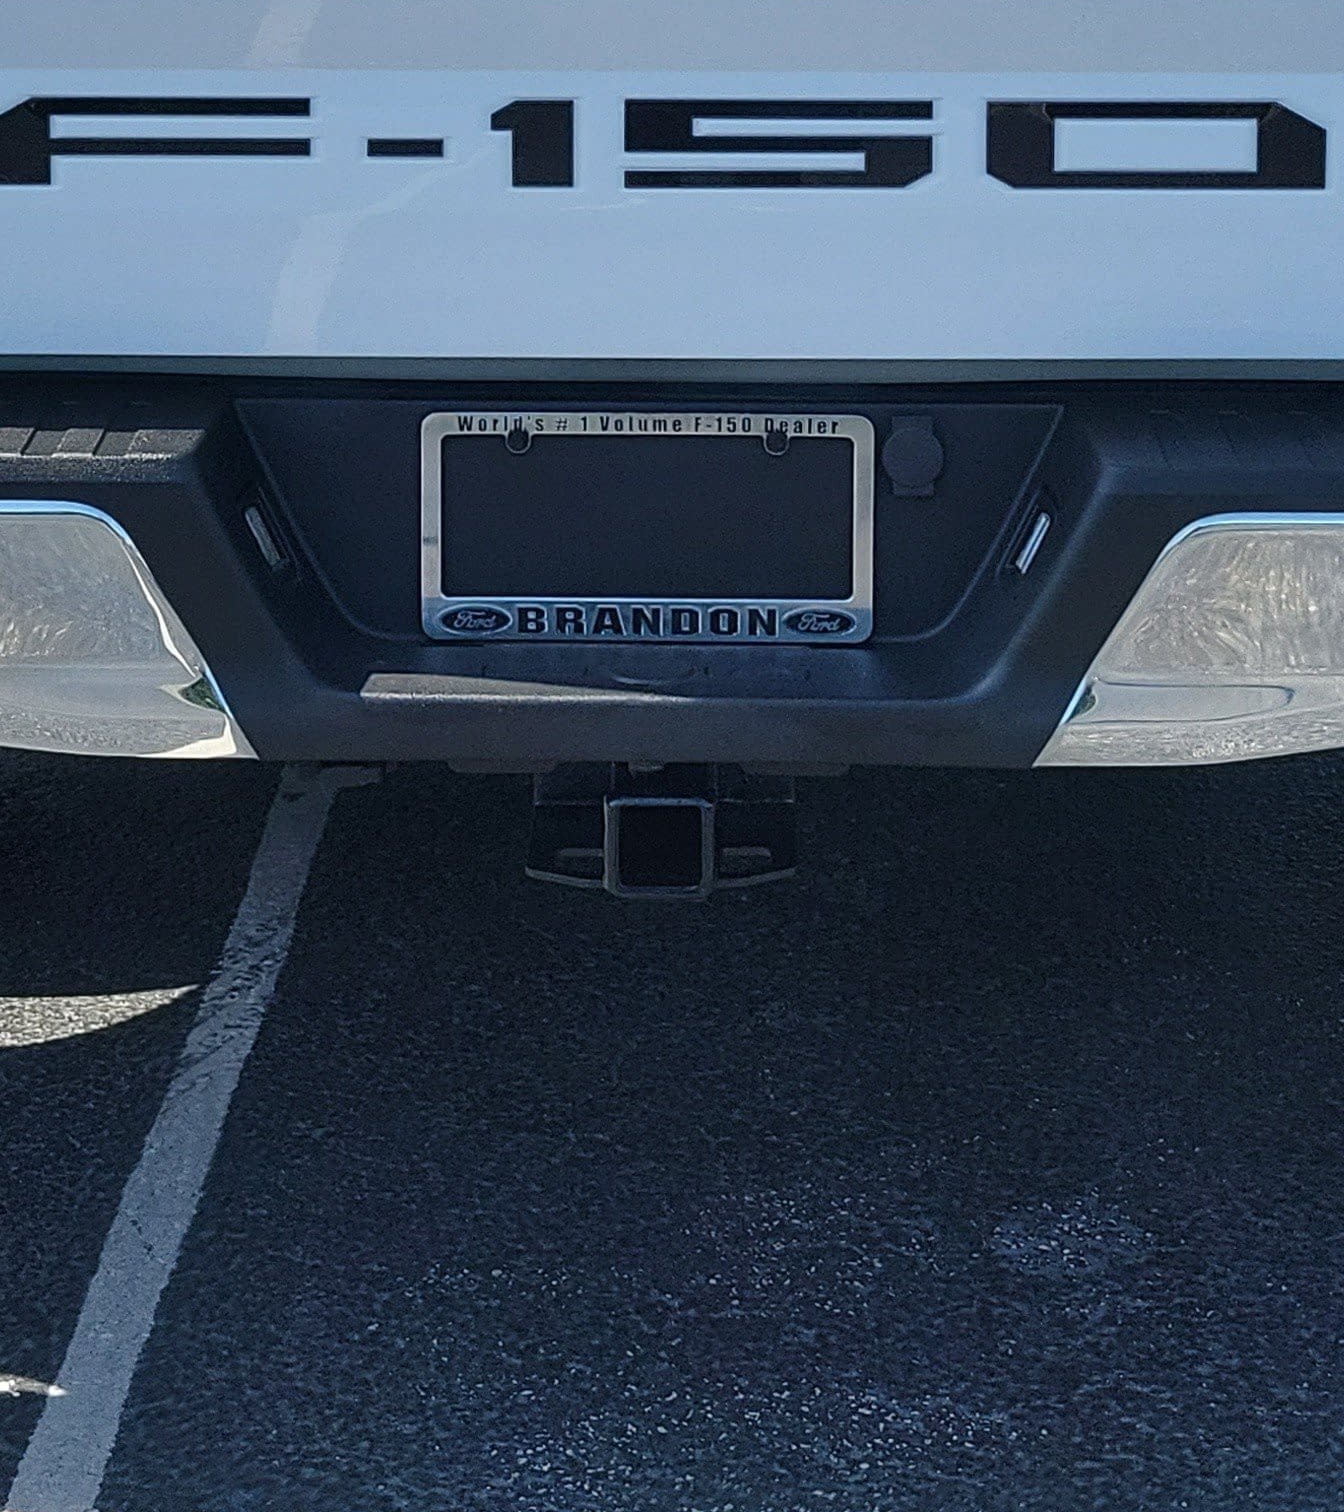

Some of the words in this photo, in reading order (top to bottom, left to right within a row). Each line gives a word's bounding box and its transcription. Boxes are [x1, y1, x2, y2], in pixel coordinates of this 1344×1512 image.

[457, 415, 545, 432] World's
[555, 417, 568, 432] #
[580, 415, 587, 432] 1
[599, 415, 683, 433] Volume
[694, 416, 752, 433] F-150
[764, 417, 840, 435] Dealer
[453, 610, 497, 628] Ford
[516, 604, 779, 637] BRANDON
[797, 613, 841, 631] Ford
